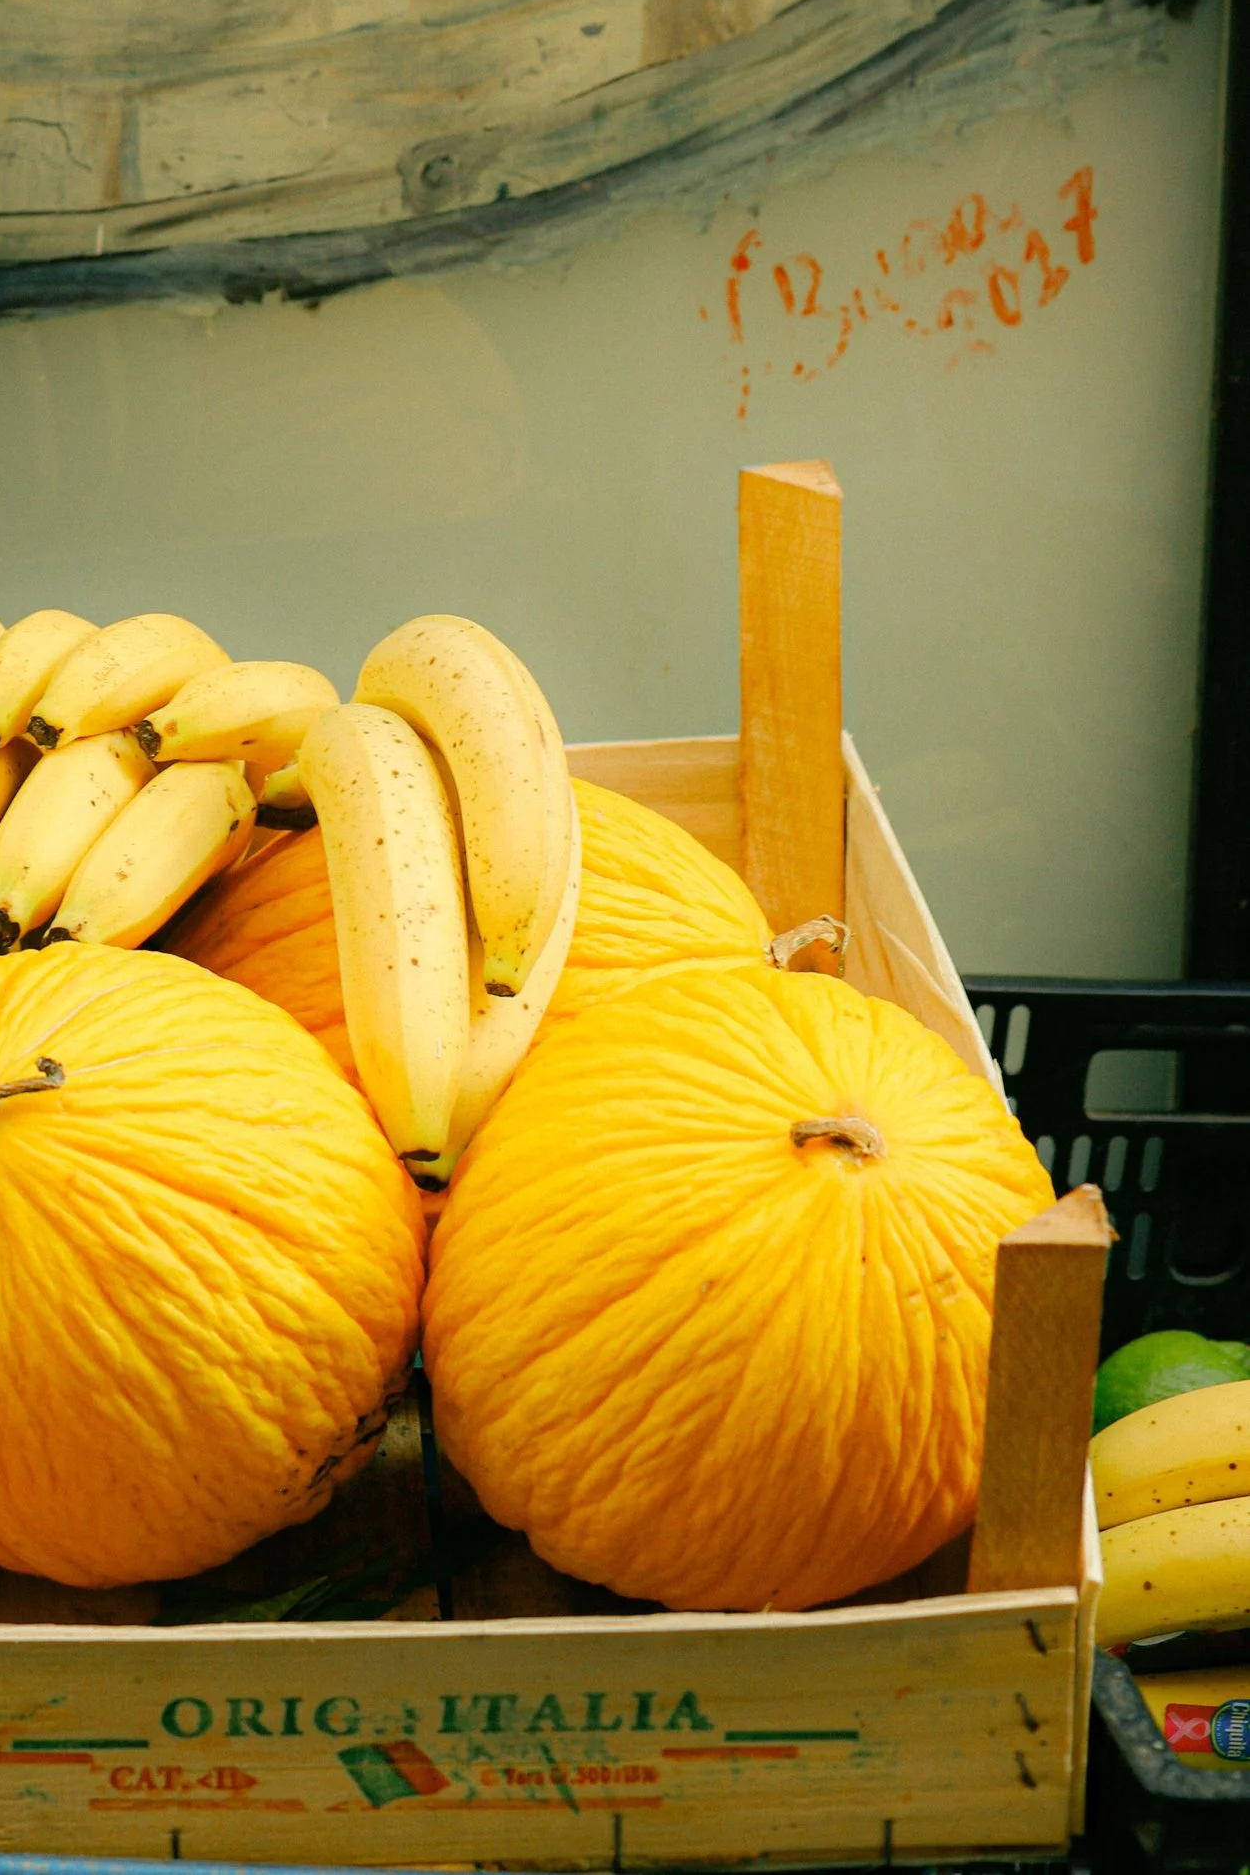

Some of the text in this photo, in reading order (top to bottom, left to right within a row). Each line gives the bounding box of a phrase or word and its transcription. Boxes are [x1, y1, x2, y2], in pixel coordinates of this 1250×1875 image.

[437, 1689, 715, 1735] ITALIA
[1224, 1702, 1249, 1757] Chiquita
[109, 1765, 193, 1793] CAT.
